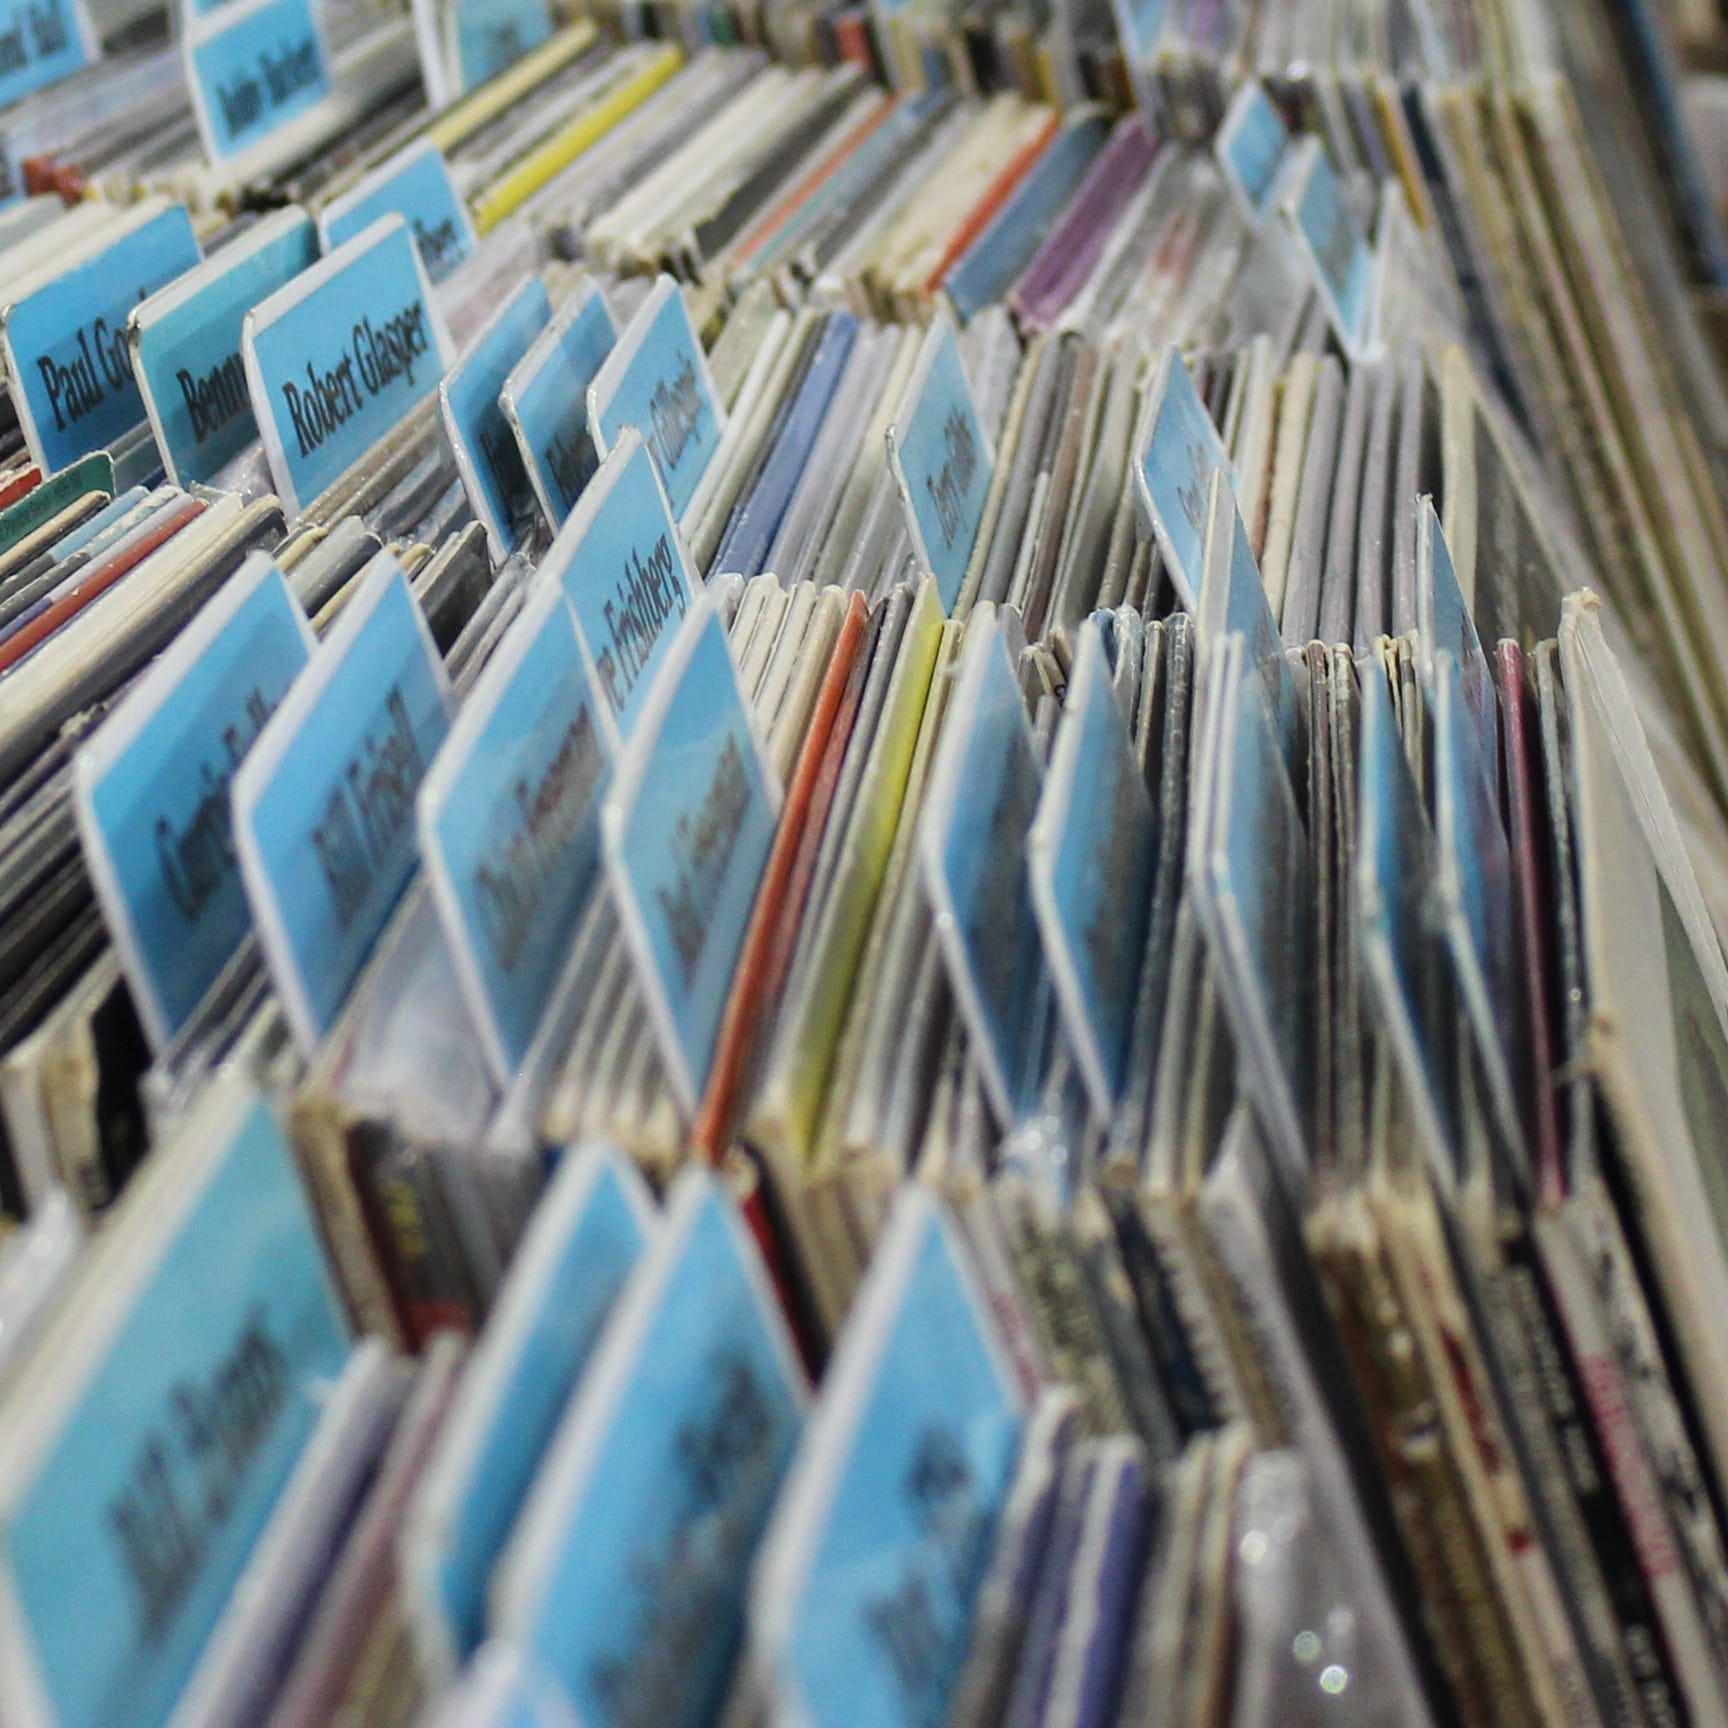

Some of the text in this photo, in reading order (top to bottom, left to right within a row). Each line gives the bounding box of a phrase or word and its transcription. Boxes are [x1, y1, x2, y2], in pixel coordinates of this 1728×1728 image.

[36, 327, 105, 432] Paul
[282, 346, 364, 459] Robert
[352, 299, 429, 396] Glasper
[603, 532, 687, 696] Frishberg
